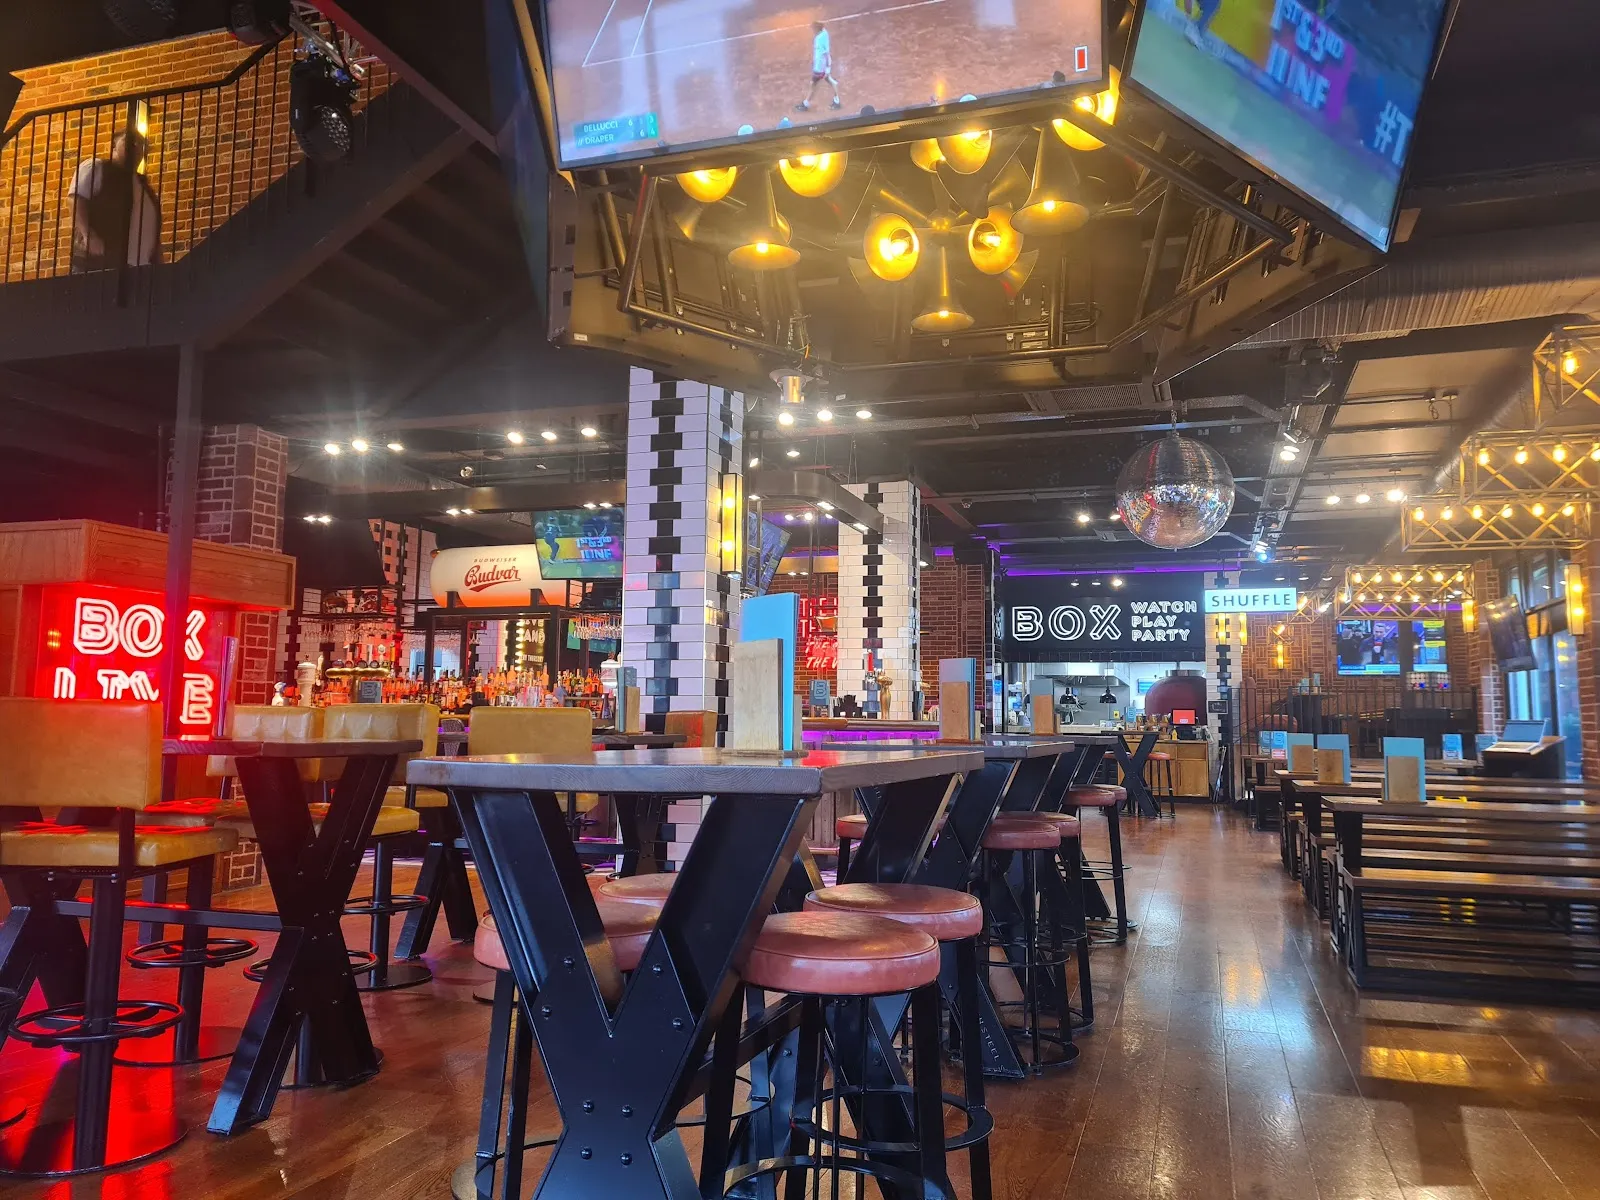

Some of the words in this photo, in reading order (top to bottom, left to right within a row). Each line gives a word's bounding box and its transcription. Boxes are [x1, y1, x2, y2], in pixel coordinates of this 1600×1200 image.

[583, 120, 618, 133] BELLUCCI
[585, 133, 614, 145] DRAPER
[464, 565, 521, 588] Budvar
[1212, 593, 1291, 607] SHUFFLE
[1011, 604, 1121, 641] BOX
[1130, 601, 1197, 614] WATCH
[1131, 615, 1177, 628] PLAY
[1131, 628, 1190, 642] PARTY
[806, 656, 830, 669] THE
[981, 1026, 1000, 1061] STEEL
